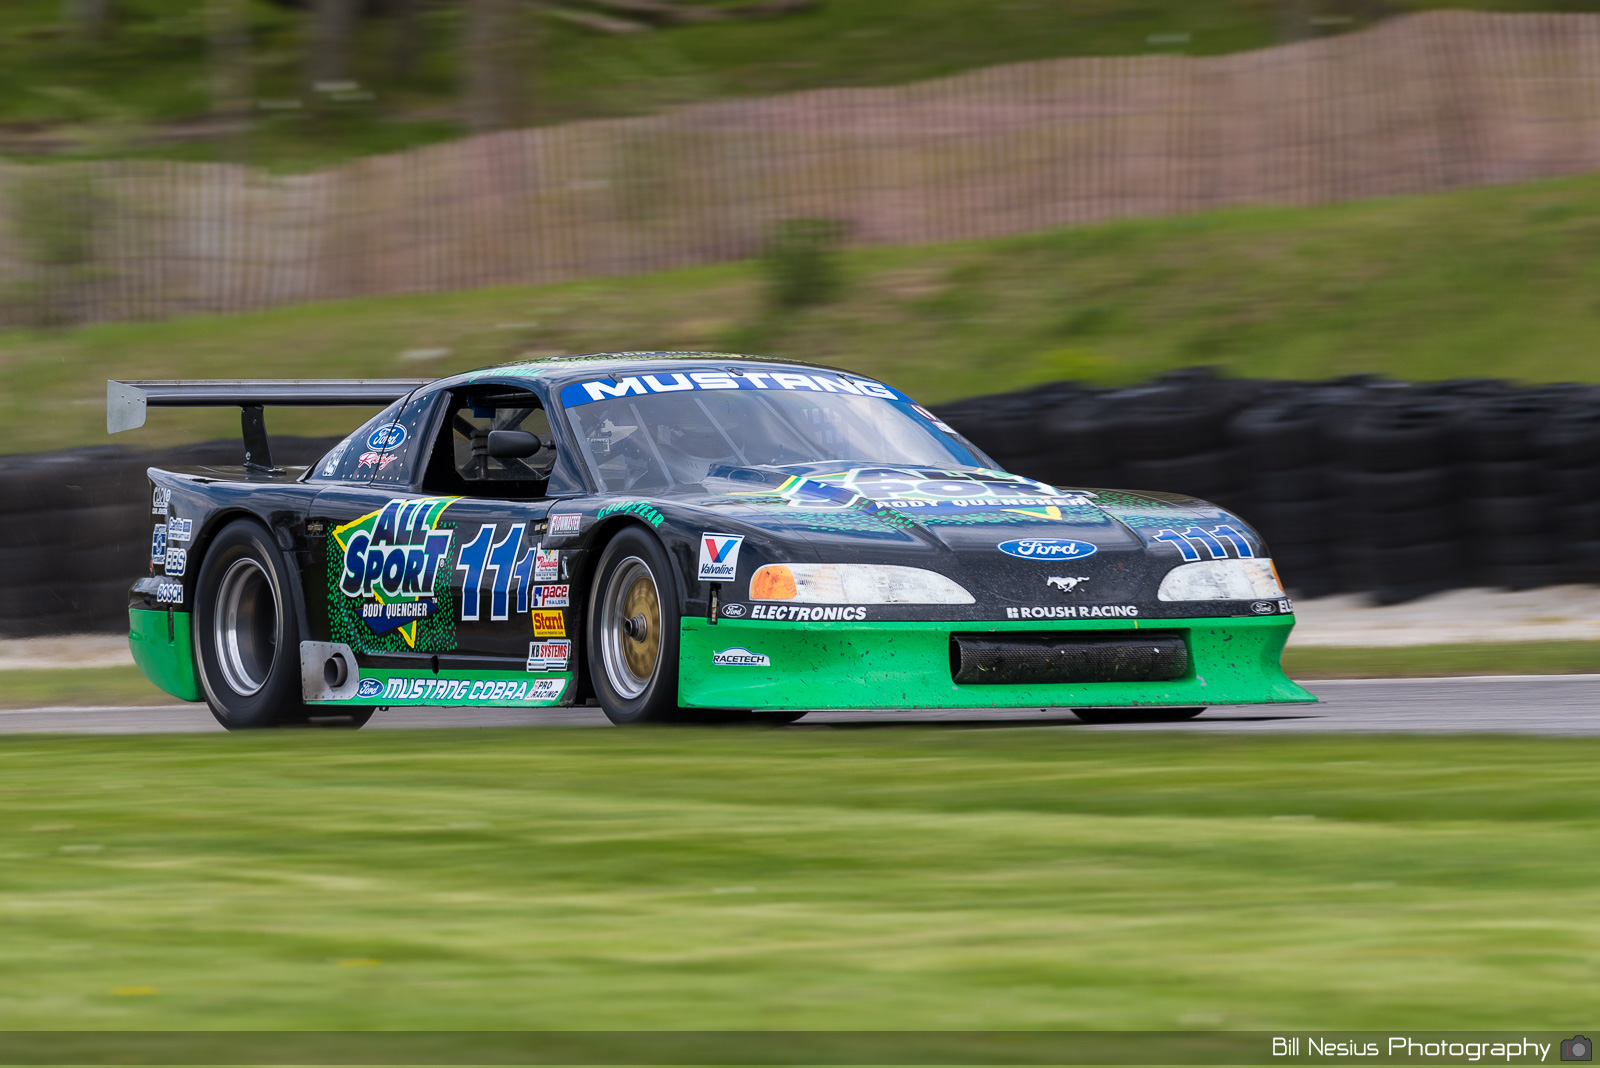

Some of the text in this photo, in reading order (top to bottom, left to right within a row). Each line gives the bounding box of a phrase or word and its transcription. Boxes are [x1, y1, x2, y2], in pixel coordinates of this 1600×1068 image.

[582, 371, 899, 402] MUSTANG
[372, 427, 399, 446] Ford
[951, 496, 1089, 508] QUENCHER
[369, 498, 440, 547] ALL
[597, 501, 665, 529] GOODYEAR
[1016, 540, 1080, 556] Ford
[1152, 525, 1254, 562] 111
[167, 548, 186, 575] BBS
[339, 530, 454, 597] SPORT
[701, 564, 734, 575] Valvoline
[456, 523, 537, 621] 111
[157, 584, 183, 602] BOSCH
[542, 585, 568, 606] pace
[362, 603, 428, 619] BODY QUENCHER
[725, 604, 867, 621] Ford ELECTRONICS
[1022, 605, 1138, 618] ROUSH RACING
[534, 612, 564, 630] Stant
[541, 644, 567, 657] SYSTEMS
[713, 655, 764, 663] RACETECH
[360, 679, 380, 695] Ford
[381, 678, 471, 699] MUSTANG
[468, 681, 527, 700] COBRA
[531, 690, 558, 698] RACING
[537, 681, 553, 690] PRO
